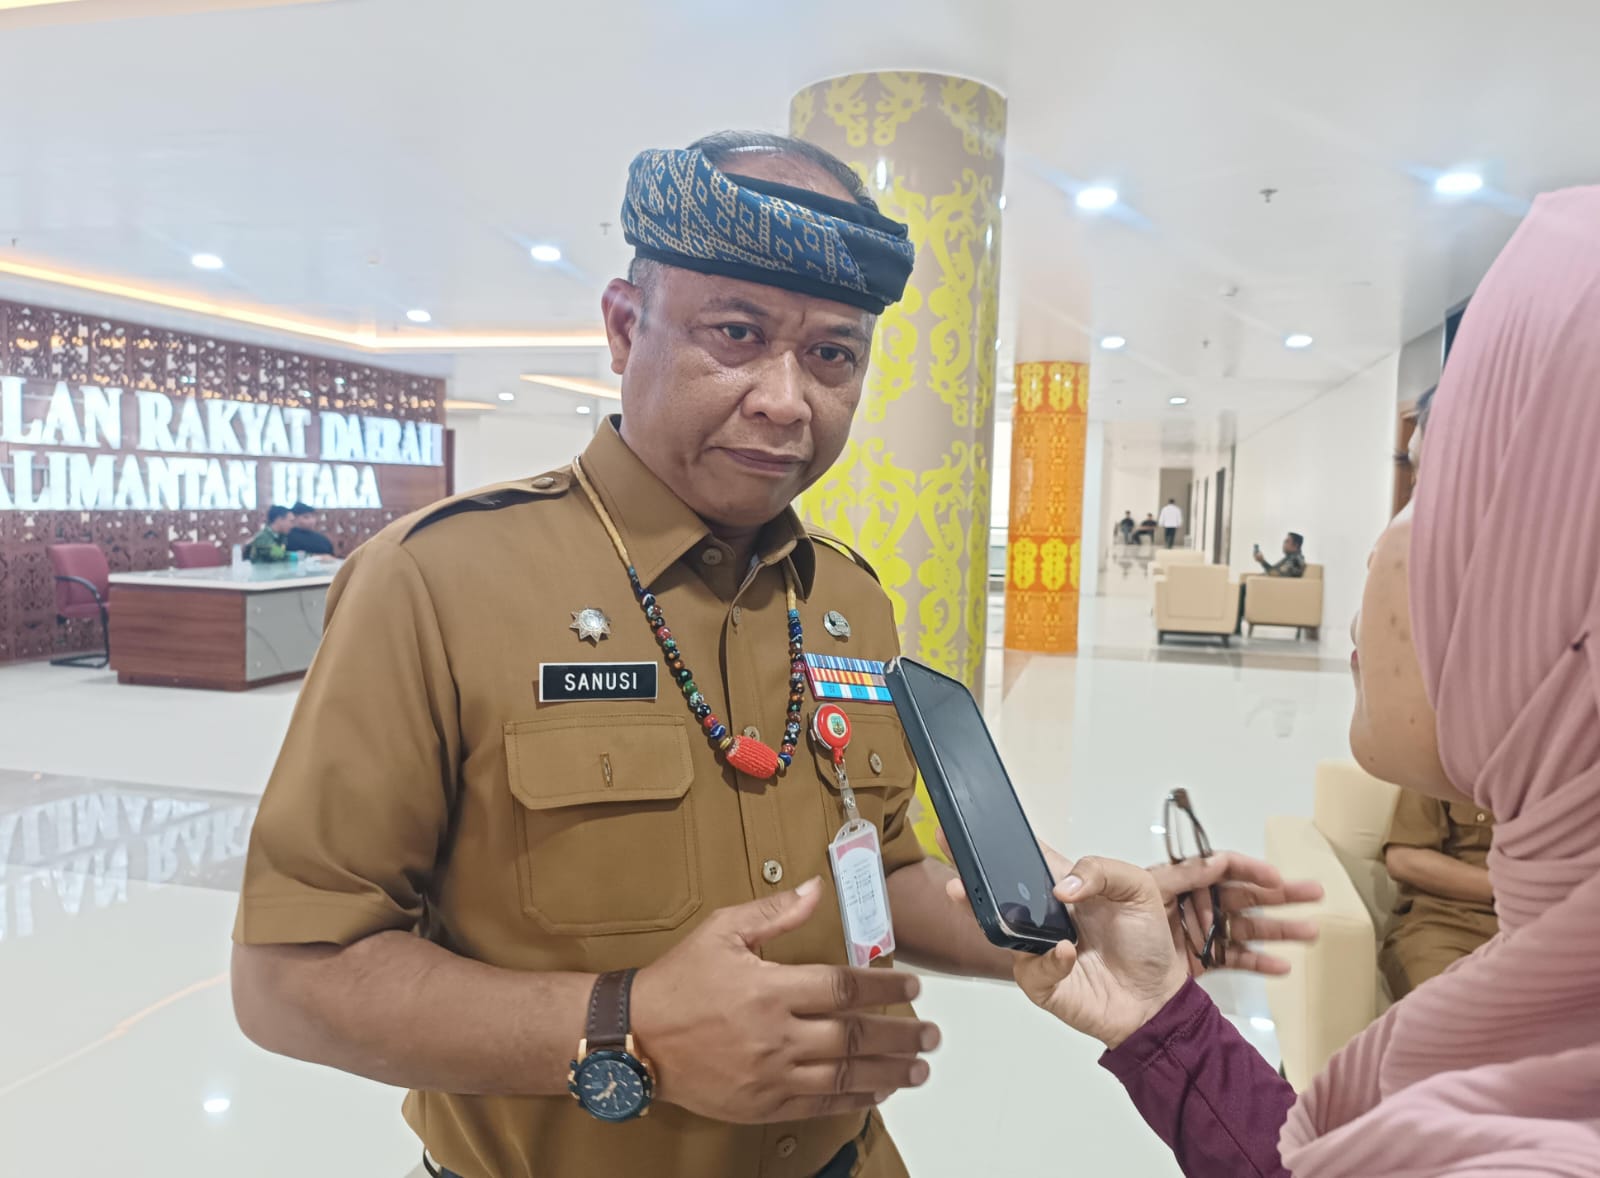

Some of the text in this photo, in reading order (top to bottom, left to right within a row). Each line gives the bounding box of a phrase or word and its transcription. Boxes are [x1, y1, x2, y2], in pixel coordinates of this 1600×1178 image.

[135, 390, 311, 458] RAKYAT
[320, 410, 444, 466] DAERAH
[271, 461, 382, 510] UTARA
[564, 672, 637, 691] SANUSI
